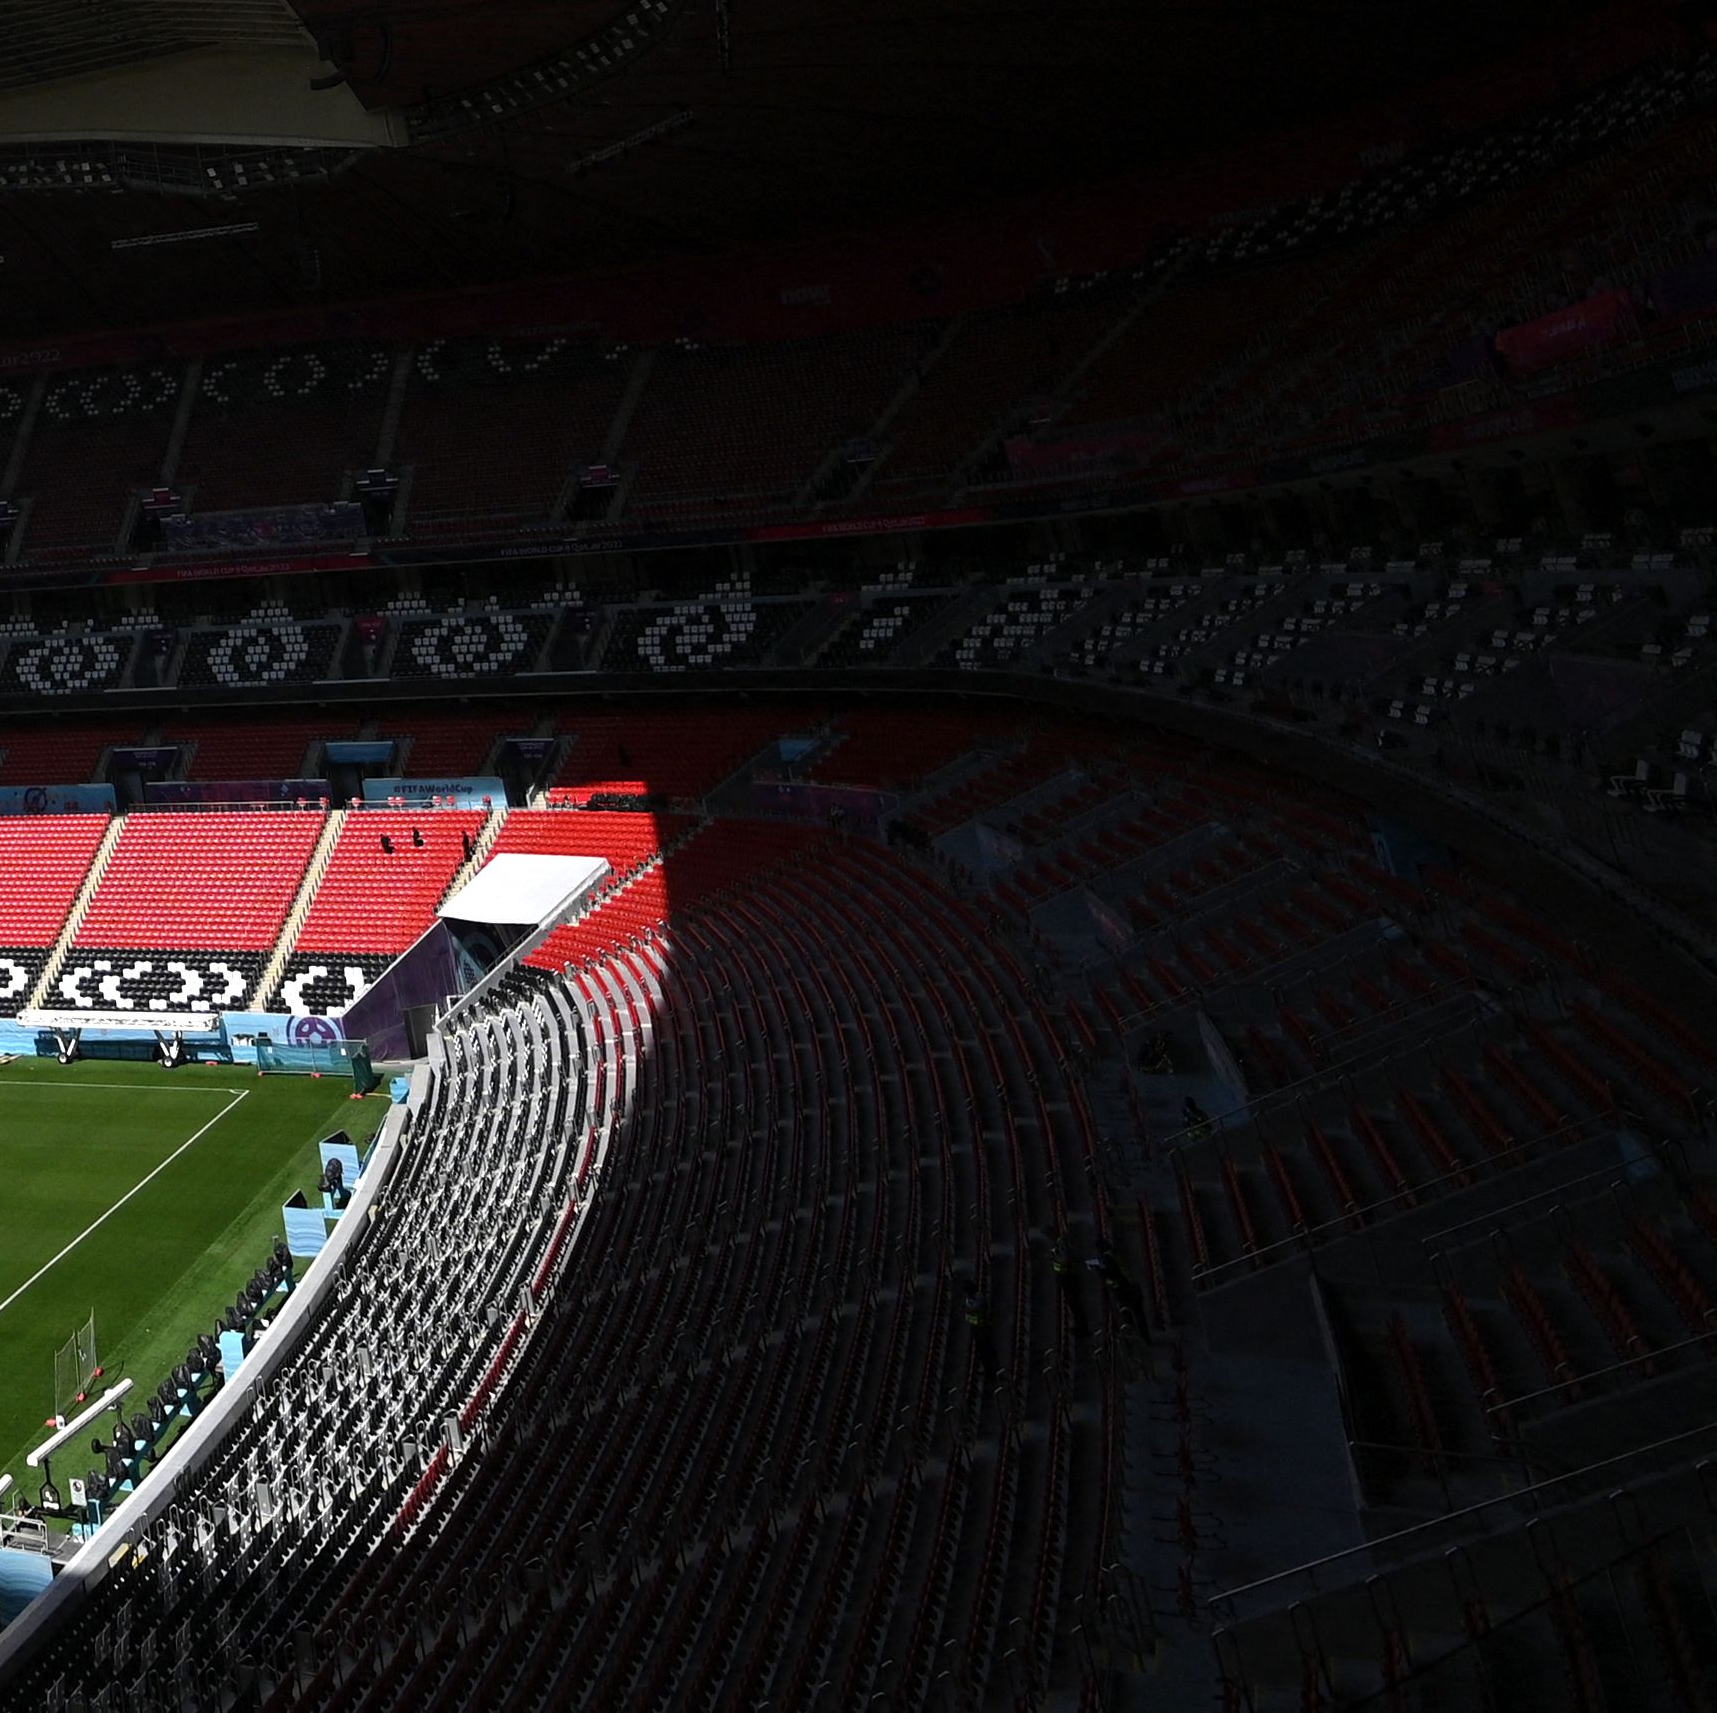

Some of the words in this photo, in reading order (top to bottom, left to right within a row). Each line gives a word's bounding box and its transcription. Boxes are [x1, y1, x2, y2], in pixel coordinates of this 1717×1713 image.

[500, 547, 518, 556] FIFA
[518, 546, 547, 555] WORLD
[548, 544, 563, 553] CUP
[393, 783, 474, 795] #FIFAWorldCup
